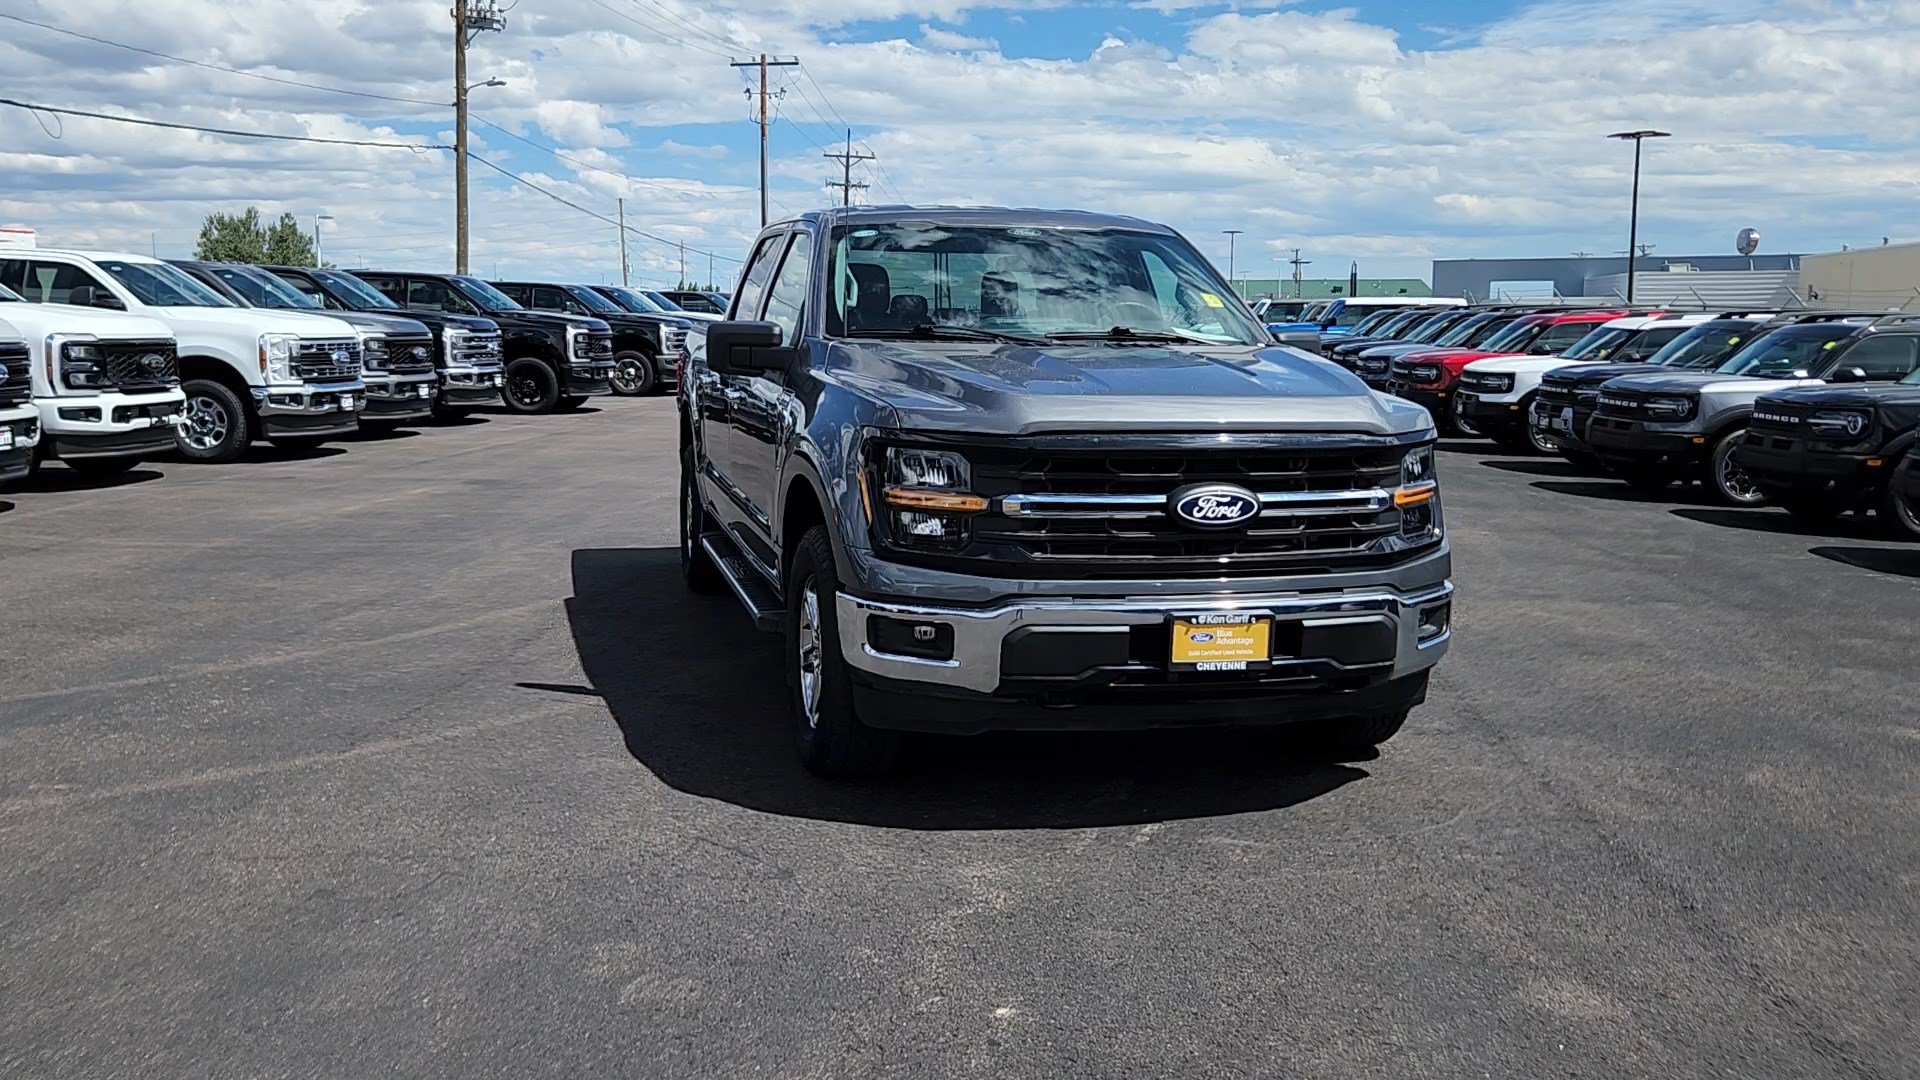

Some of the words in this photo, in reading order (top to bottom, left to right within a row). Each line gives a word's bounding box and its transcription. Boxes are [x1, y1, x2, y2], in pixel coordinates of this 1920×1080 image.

[1752, 412, 1799, 423] BRONCO
[1192, 495, 1244, 518] Ford
[1206, 615, 1225, 624] Ken
[1216, 629, 1232, 637] Blue
[1216, 637, 1254, 646] Advantage
[1196, 661, 1247, 671] CHEYENNE
